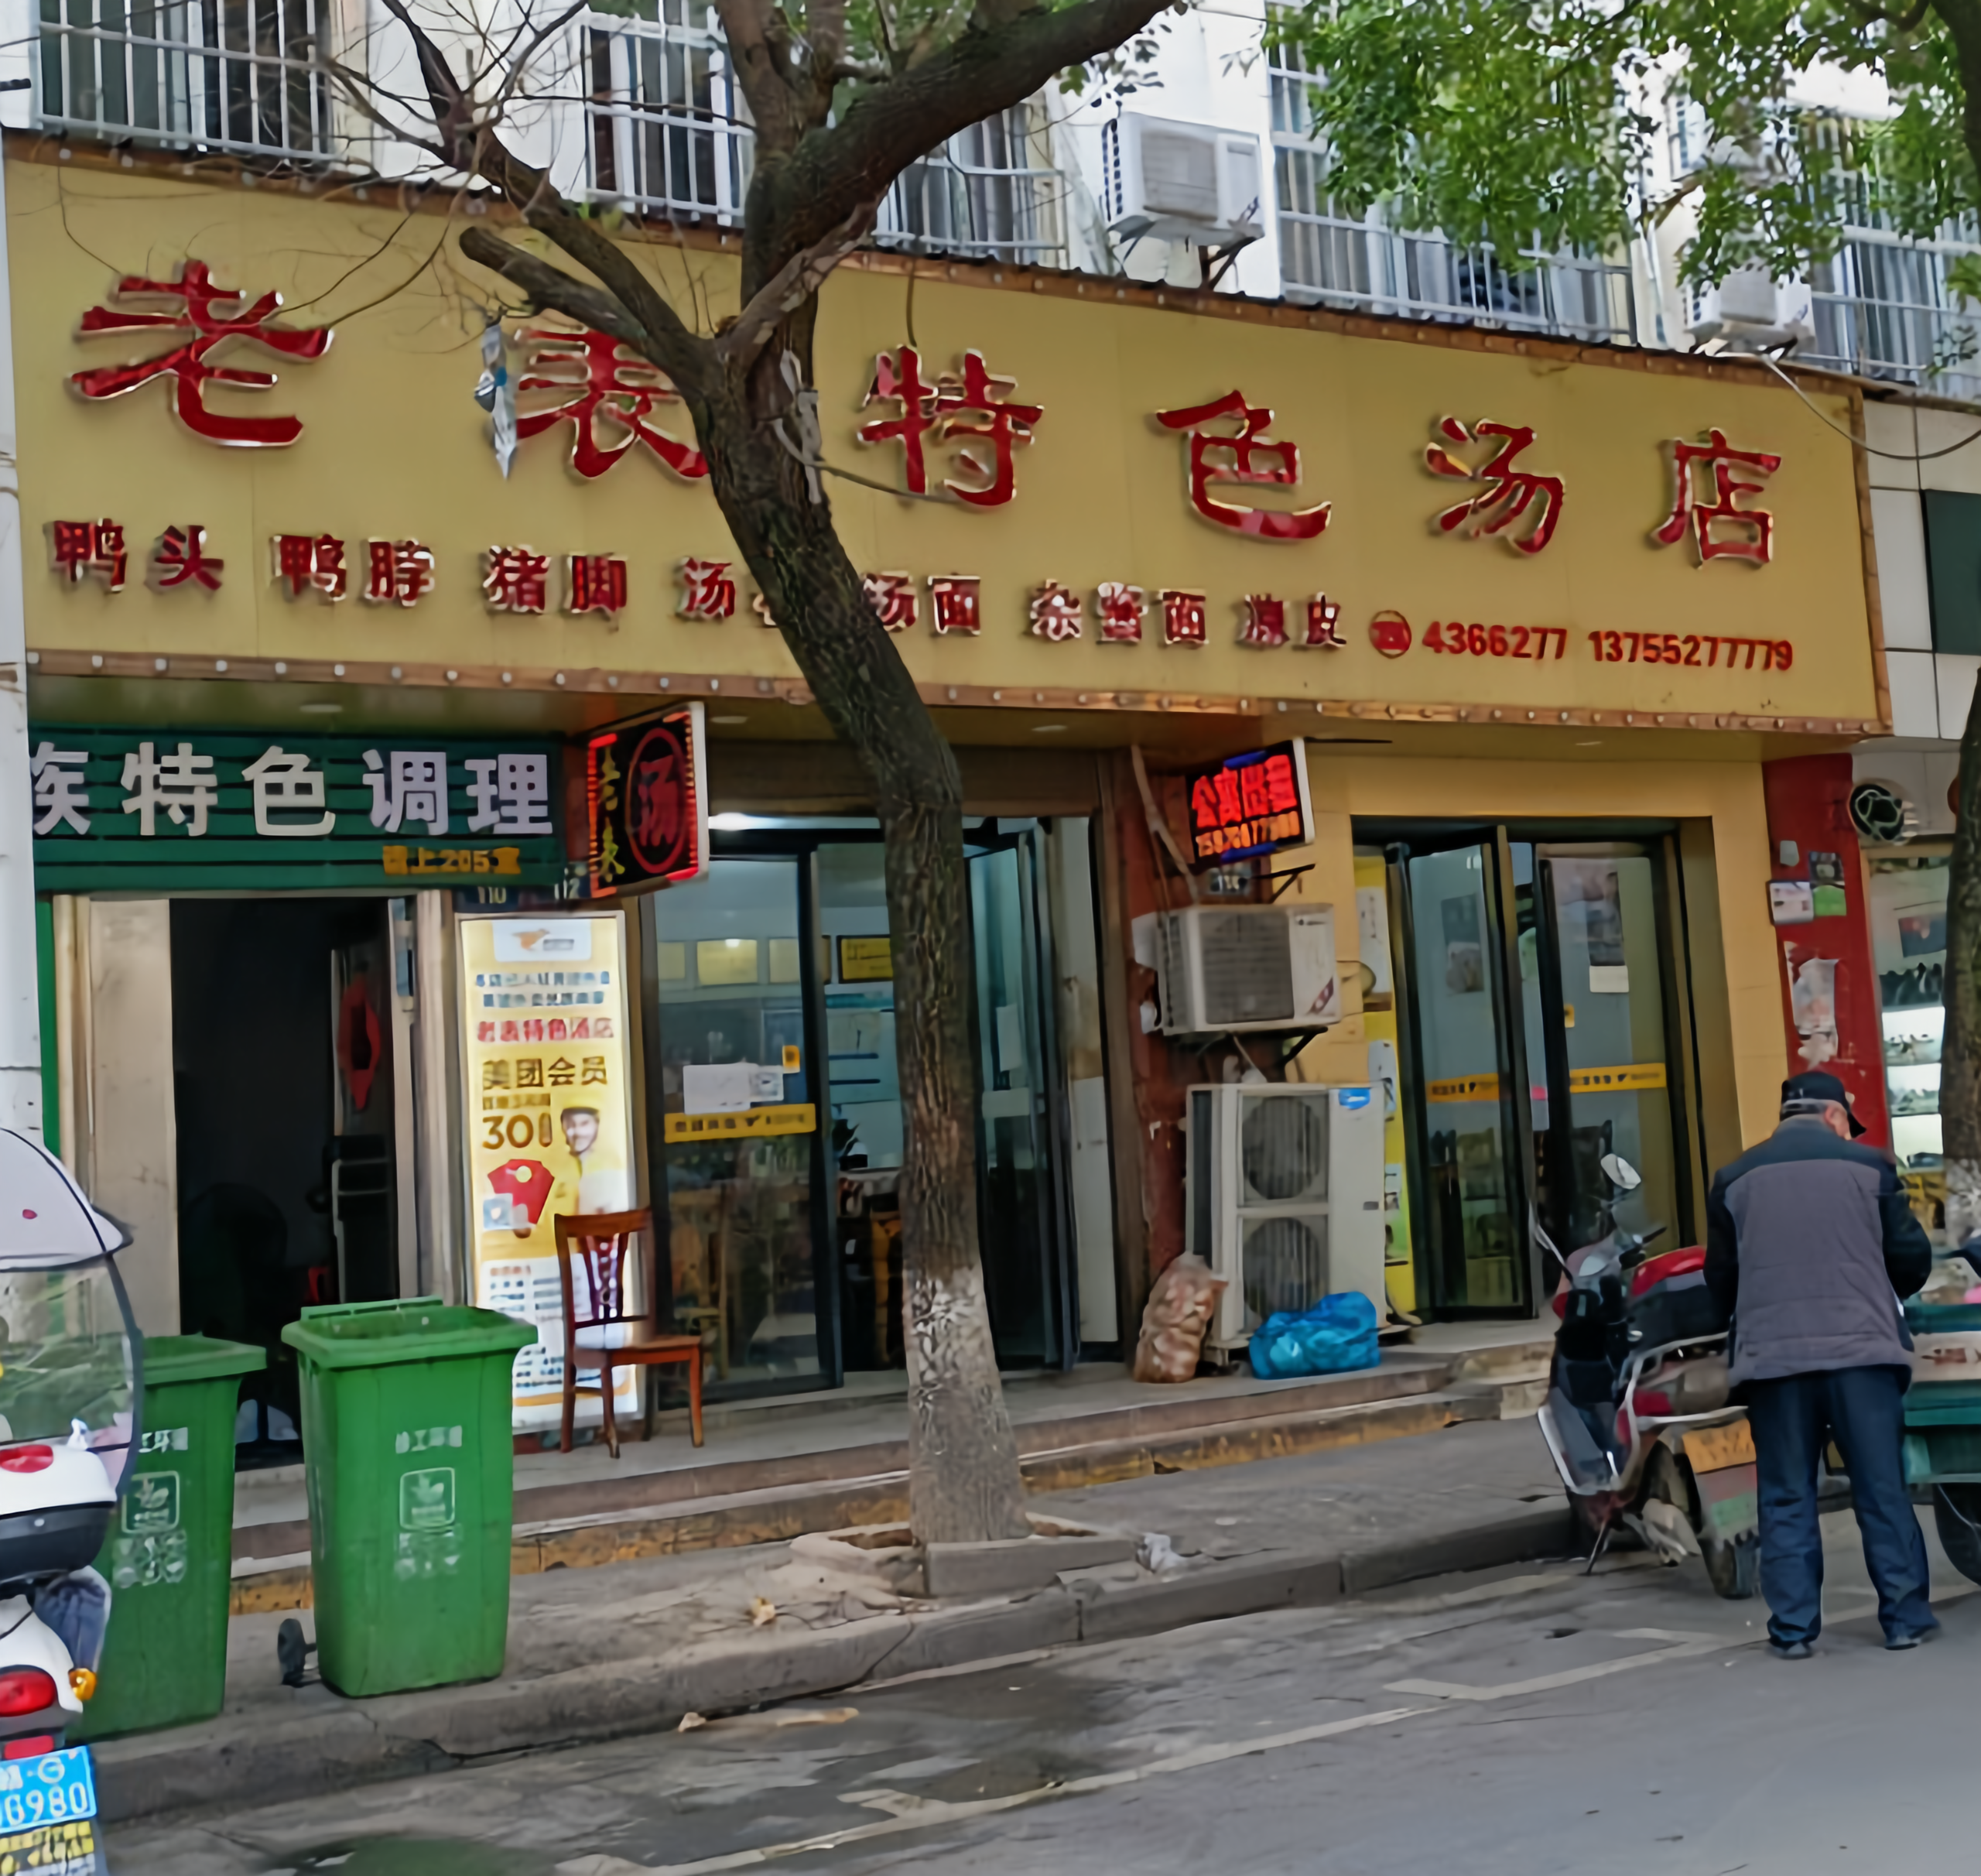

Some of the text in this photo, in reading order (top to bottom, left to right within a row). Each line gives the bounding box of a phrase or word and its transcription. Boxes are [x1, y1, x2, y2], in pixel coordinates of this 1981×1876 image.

[51, 518, 224, 593] 鸭头
[272, 533, 436, 607] 鸭脖
[1422, 621, 1568, 660] 4366277
[1588, 630, 1793, 670] 13755277779
[482, 1056, 607, 1090] 美团会员
